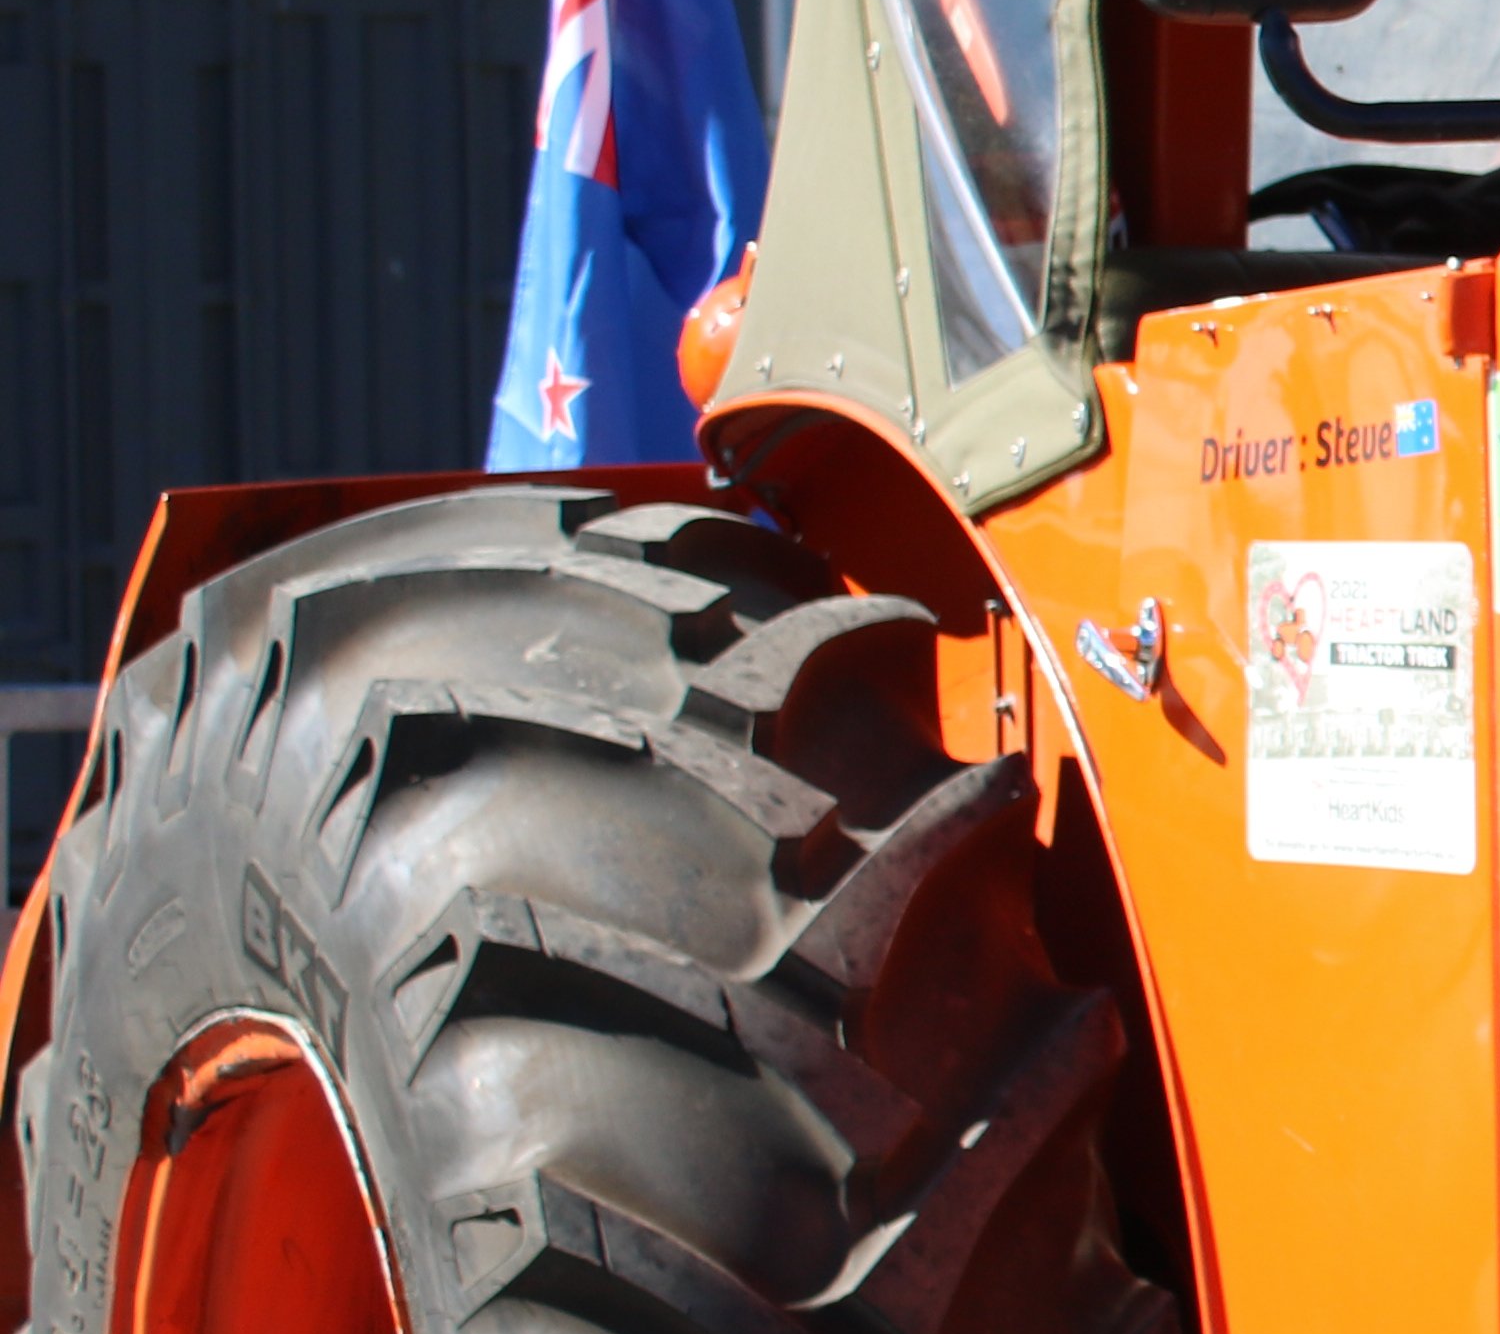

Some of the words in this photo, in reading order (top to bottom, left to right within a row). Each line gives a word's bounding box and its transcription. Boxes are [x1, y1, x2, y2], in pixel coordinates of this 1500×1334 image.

[1329, 606, 1458, 635] HEARTLAND
[1336, 643, 1405, 667] TRACTOR
[1406, 645, 1449, 668] TREK
[1328, 798, 1407, 824] HeartKids
[243, 867, 347, 1072] BKT
